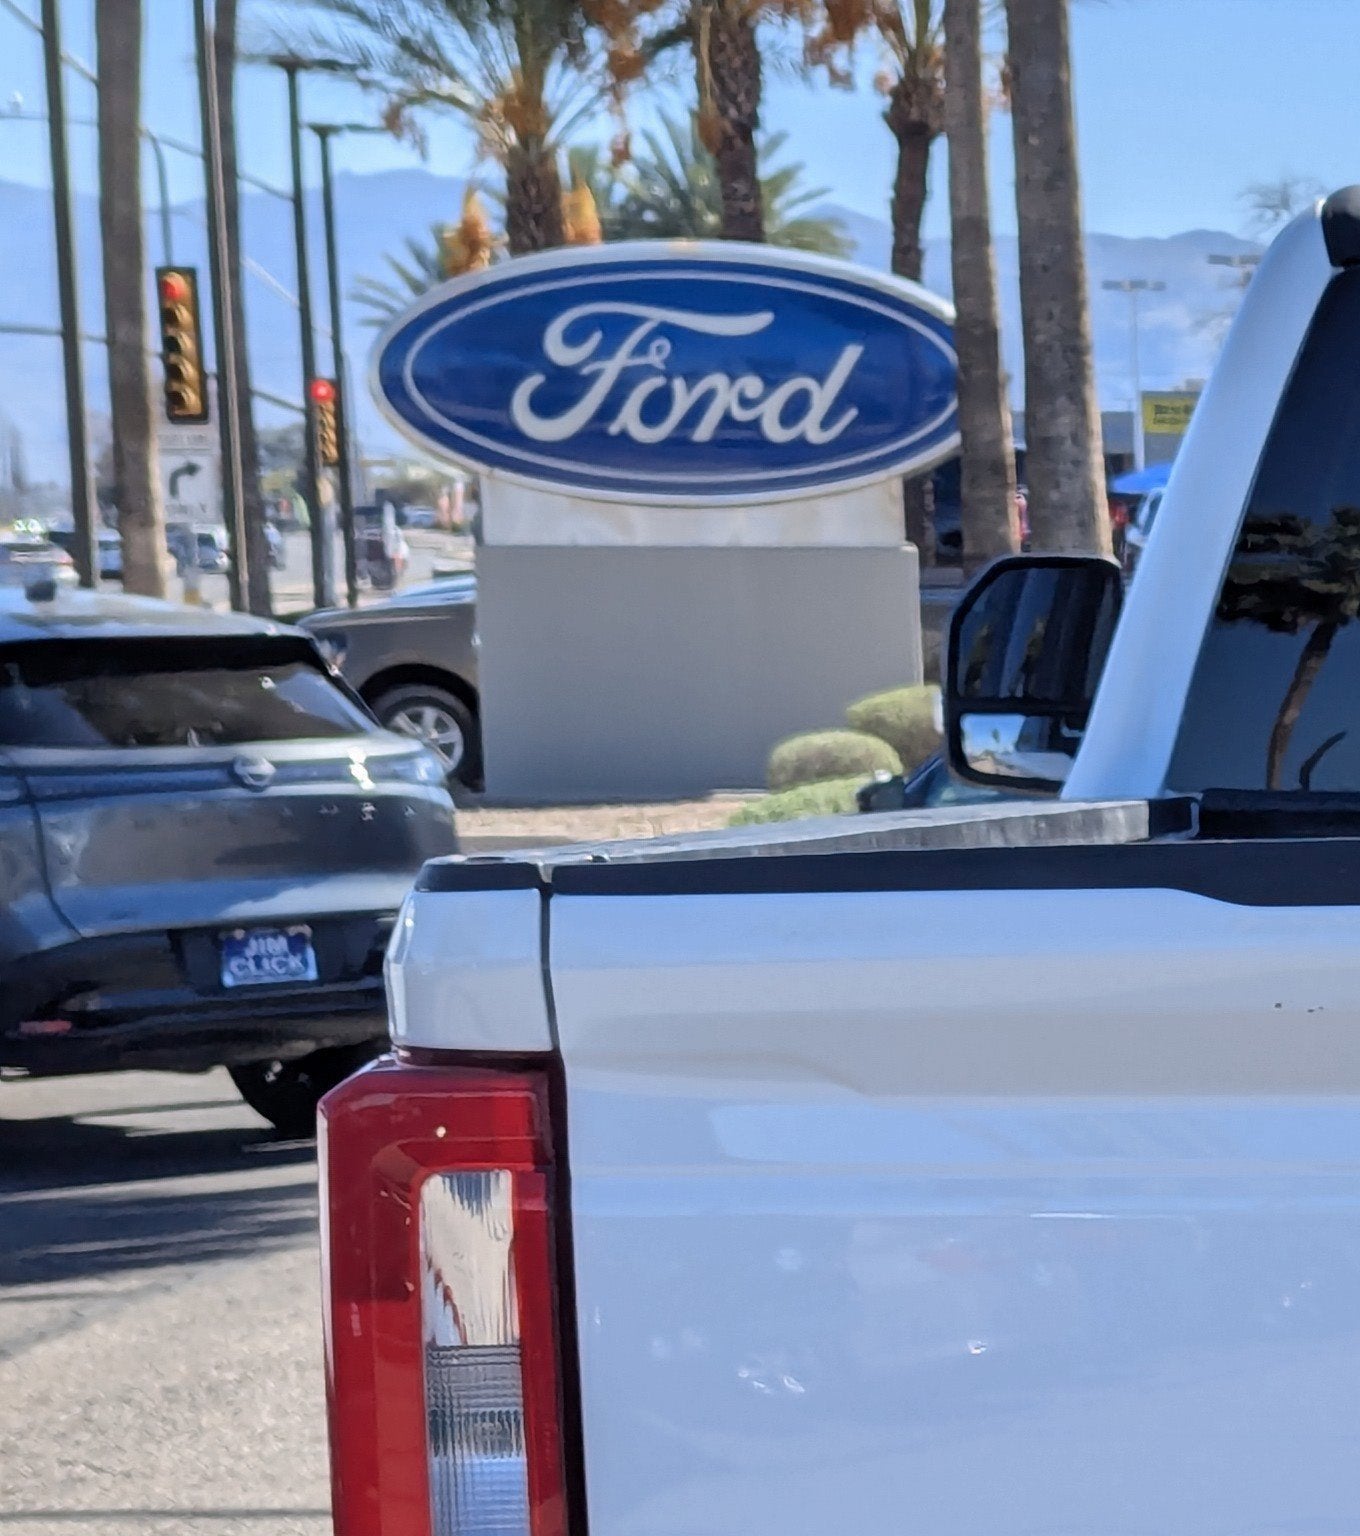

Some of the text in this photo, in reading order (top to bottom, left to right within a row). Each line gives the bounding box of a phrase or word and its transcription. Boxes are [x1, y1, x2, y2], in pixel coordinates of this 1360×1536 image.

[512, 301, 864, 444] Ford
[244, 933, 289, 957] JIM
[229, 952, 307, 978] CLICK
